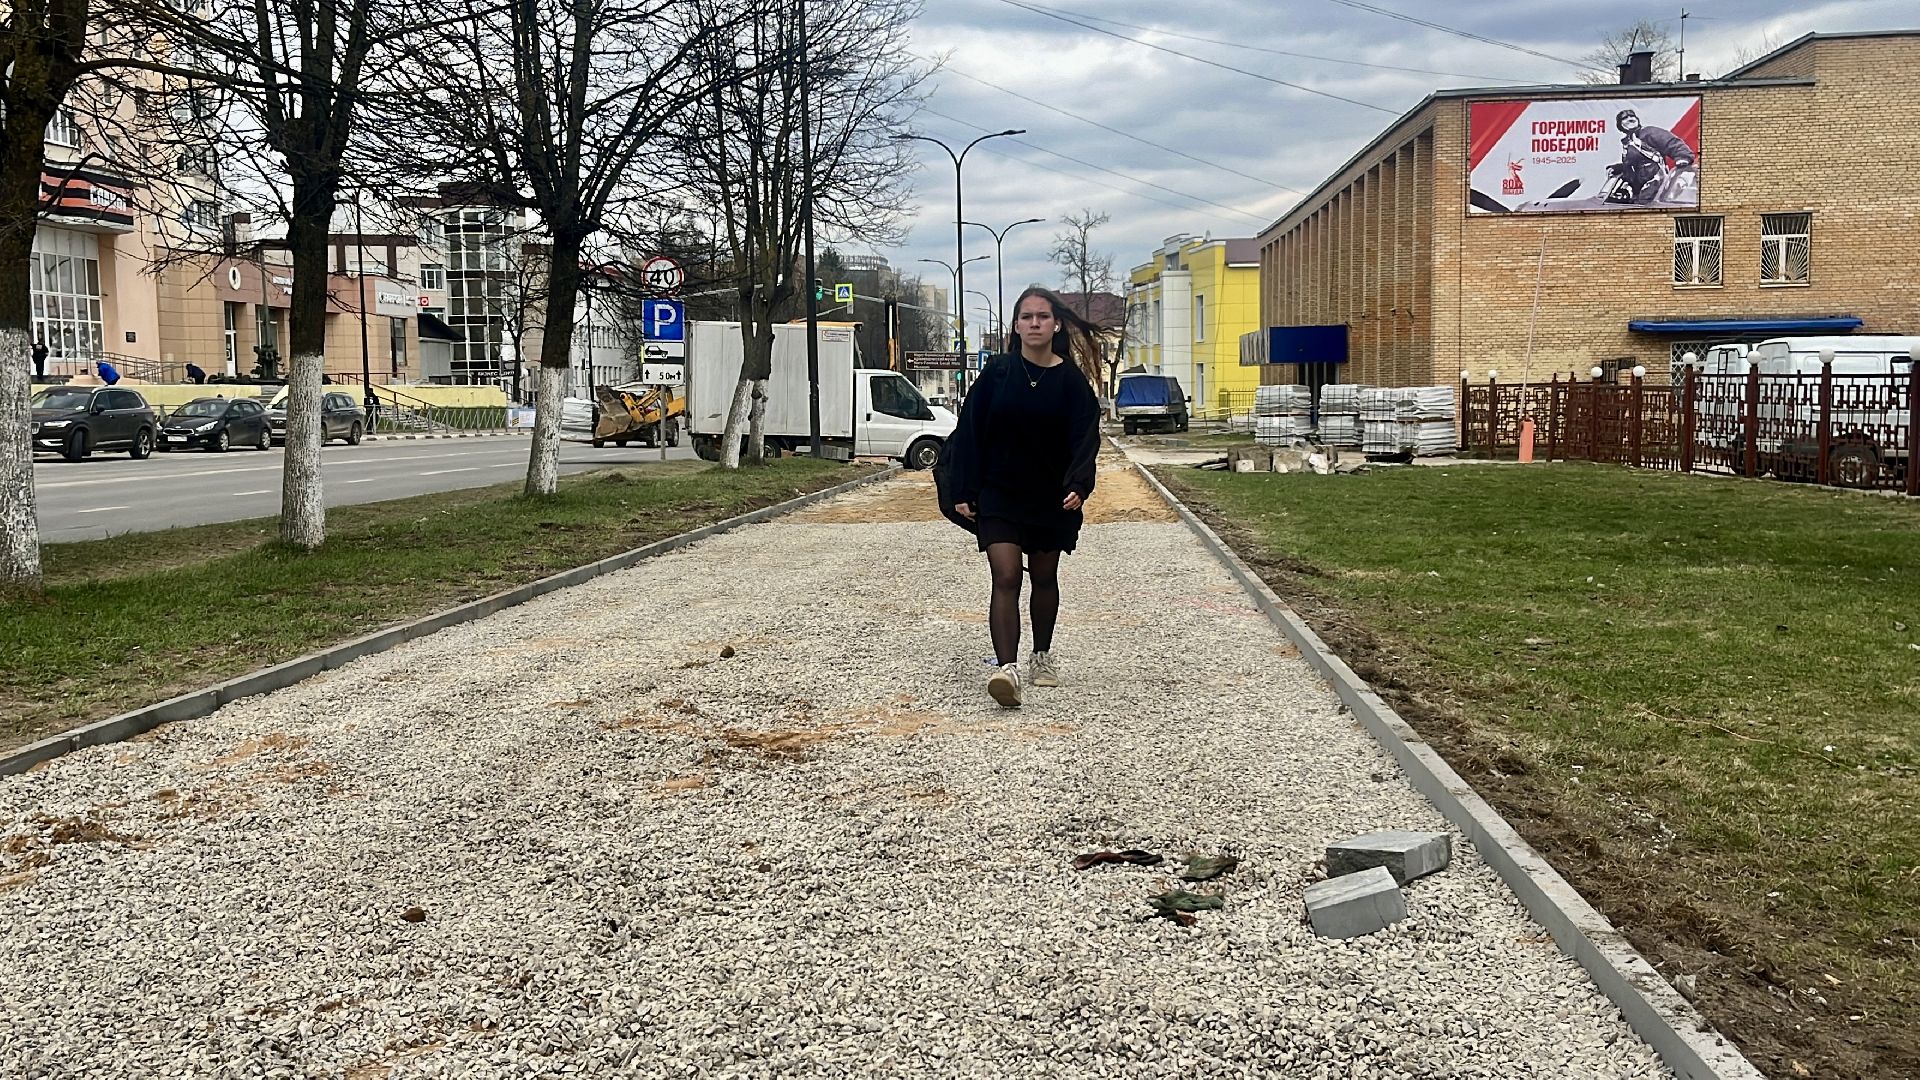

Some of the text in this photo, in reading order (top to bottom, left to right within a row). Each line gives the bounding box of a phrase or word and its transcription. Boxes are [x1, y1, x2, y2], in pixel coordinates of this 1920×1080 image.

[1532, 120, 1605, 137] ГОРДИМСЯ
[1532, 136, 1599, 153] ПОБЕДОЙ!
[1502, 179, 1514, 189] 80
[650, 269, 674, 285] 40
[654, 303, 676, 336] P
